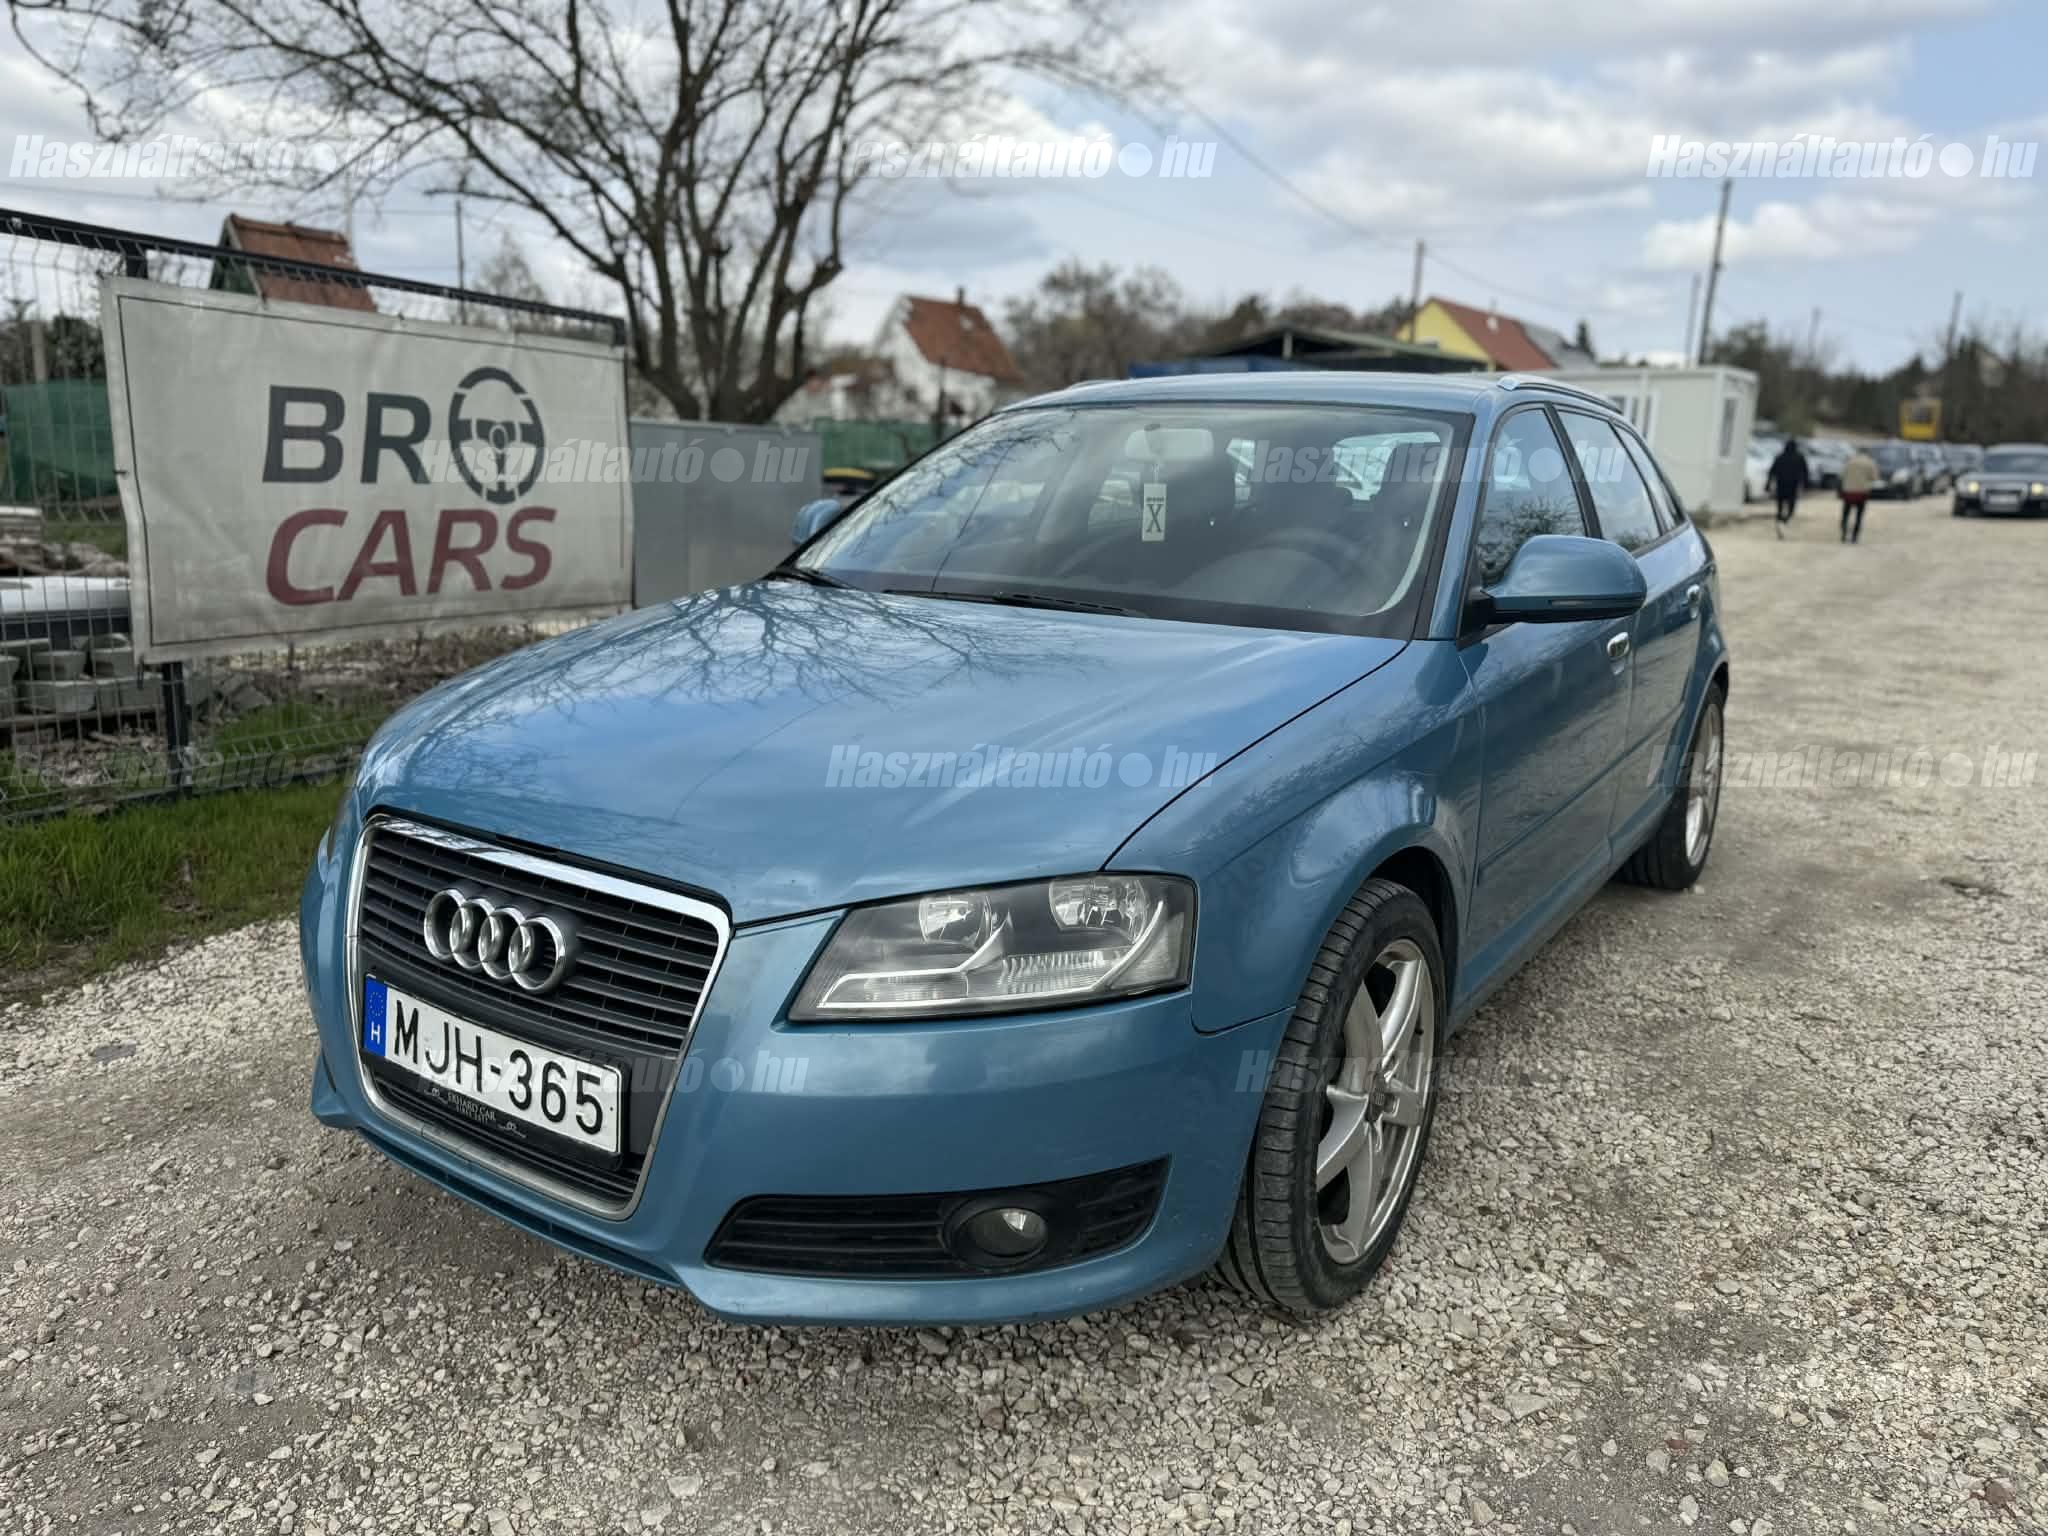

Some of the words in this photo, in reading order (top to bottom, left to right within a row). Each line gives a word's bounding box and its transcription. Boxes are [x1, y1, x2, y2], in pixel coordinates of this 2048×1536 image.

[265, 507, 556, 606] CARS
[370, 1023, 381, 1045] H
[394, 1000, 604, 1136] MJH-365
